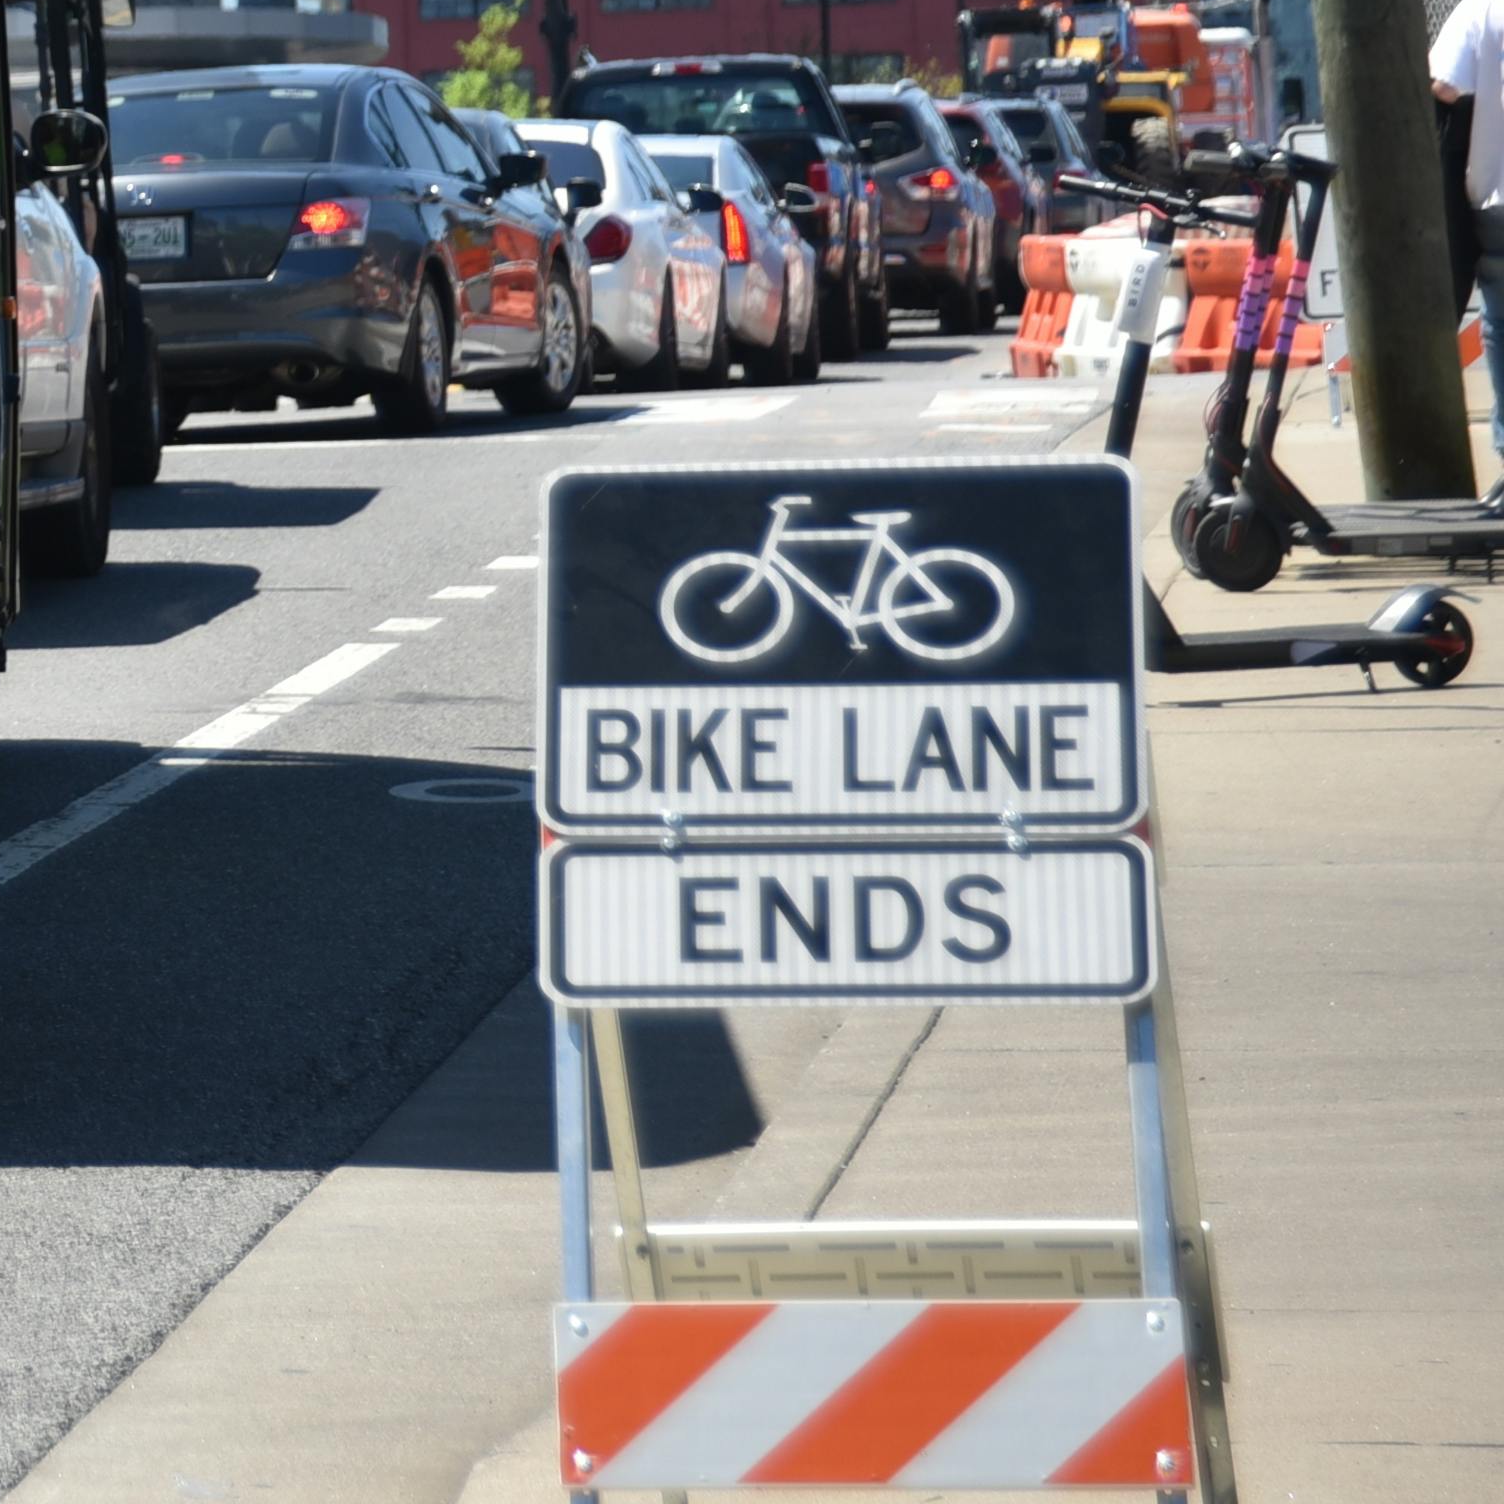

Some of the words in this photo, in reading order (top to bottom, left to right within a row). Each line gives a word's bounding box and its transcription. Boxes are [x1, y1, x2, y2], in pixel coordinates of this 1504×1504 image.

[1127, 263, 1146, 308] BIRD
[587, 707, 792, 793] BIKE
[842, 705, 1095, 792] LANE
[679, 874, 1012, 964] ENDS
